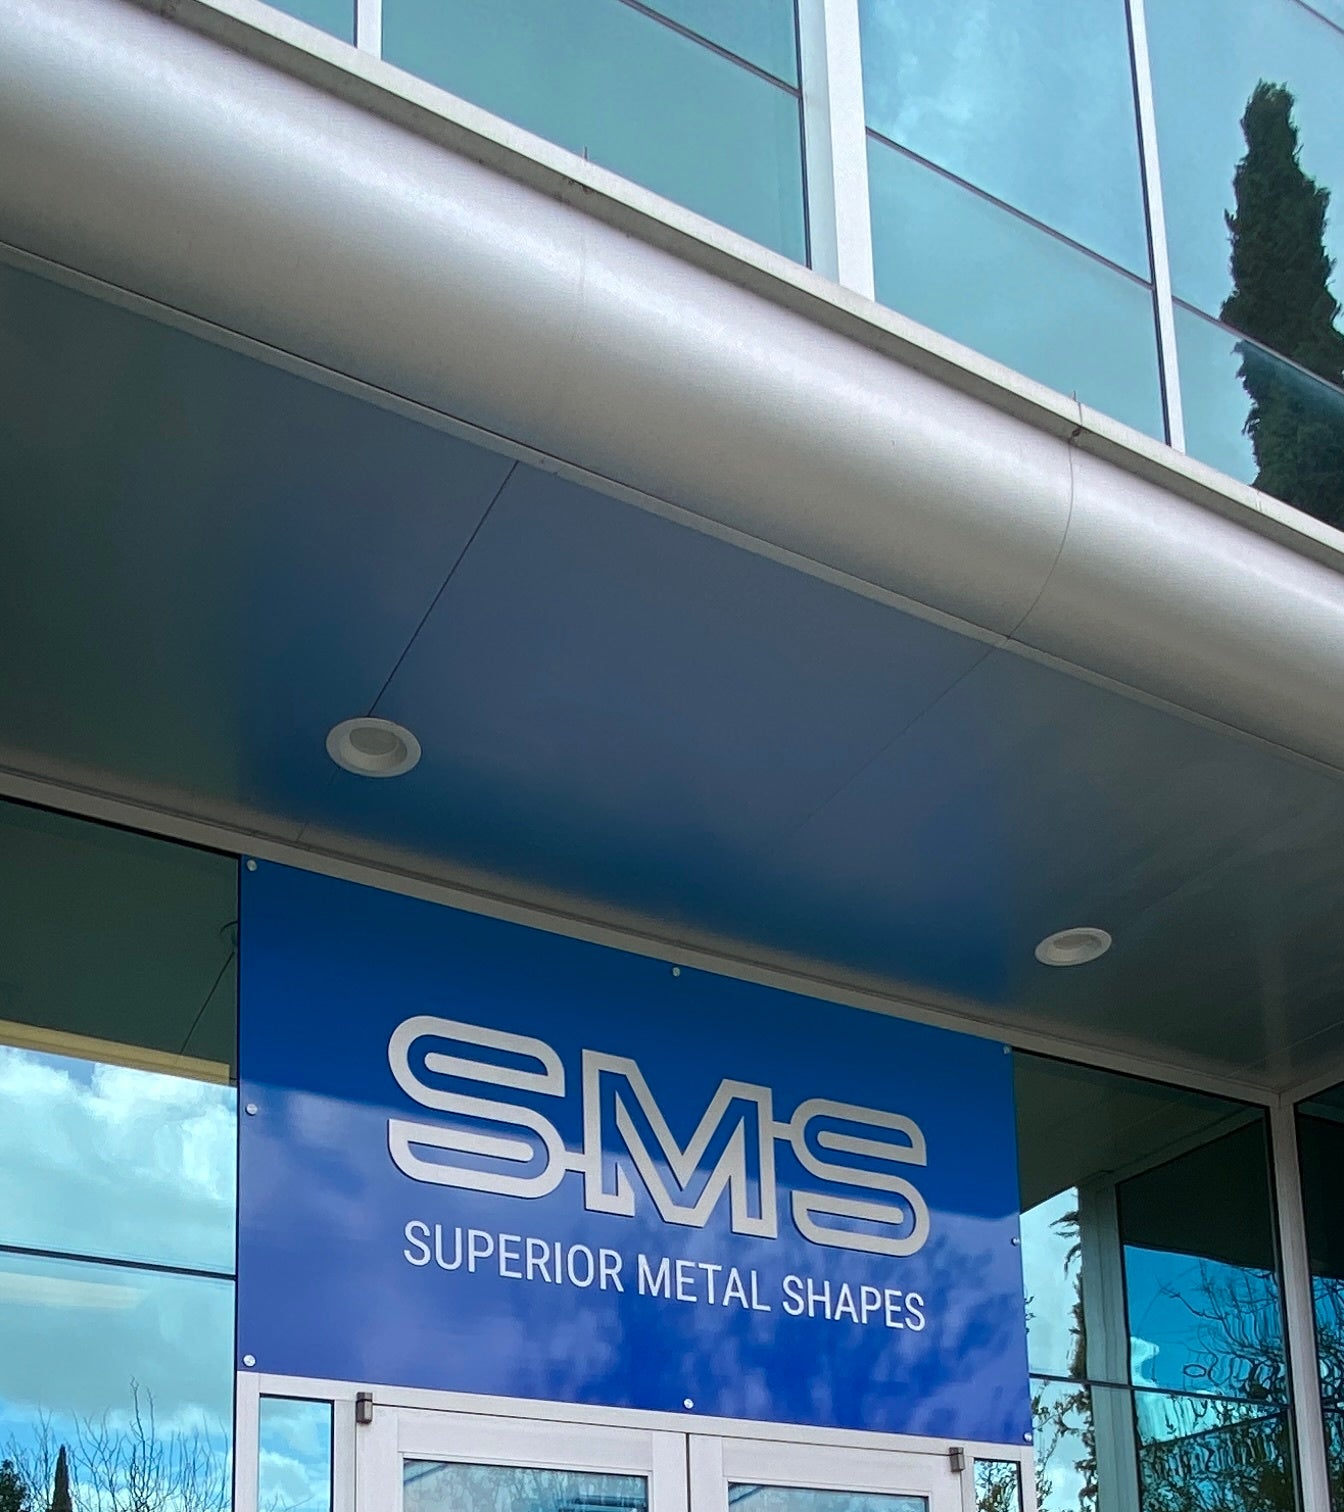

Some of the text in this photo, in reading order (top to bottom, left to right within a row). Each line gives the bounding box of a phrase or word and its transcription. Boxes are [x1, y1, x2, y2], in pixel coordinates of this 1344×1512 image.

[387, 1015, 931, 1257] SMS
[403, 1220, 926, 1331] SUPERIOR METAL SHAPES
